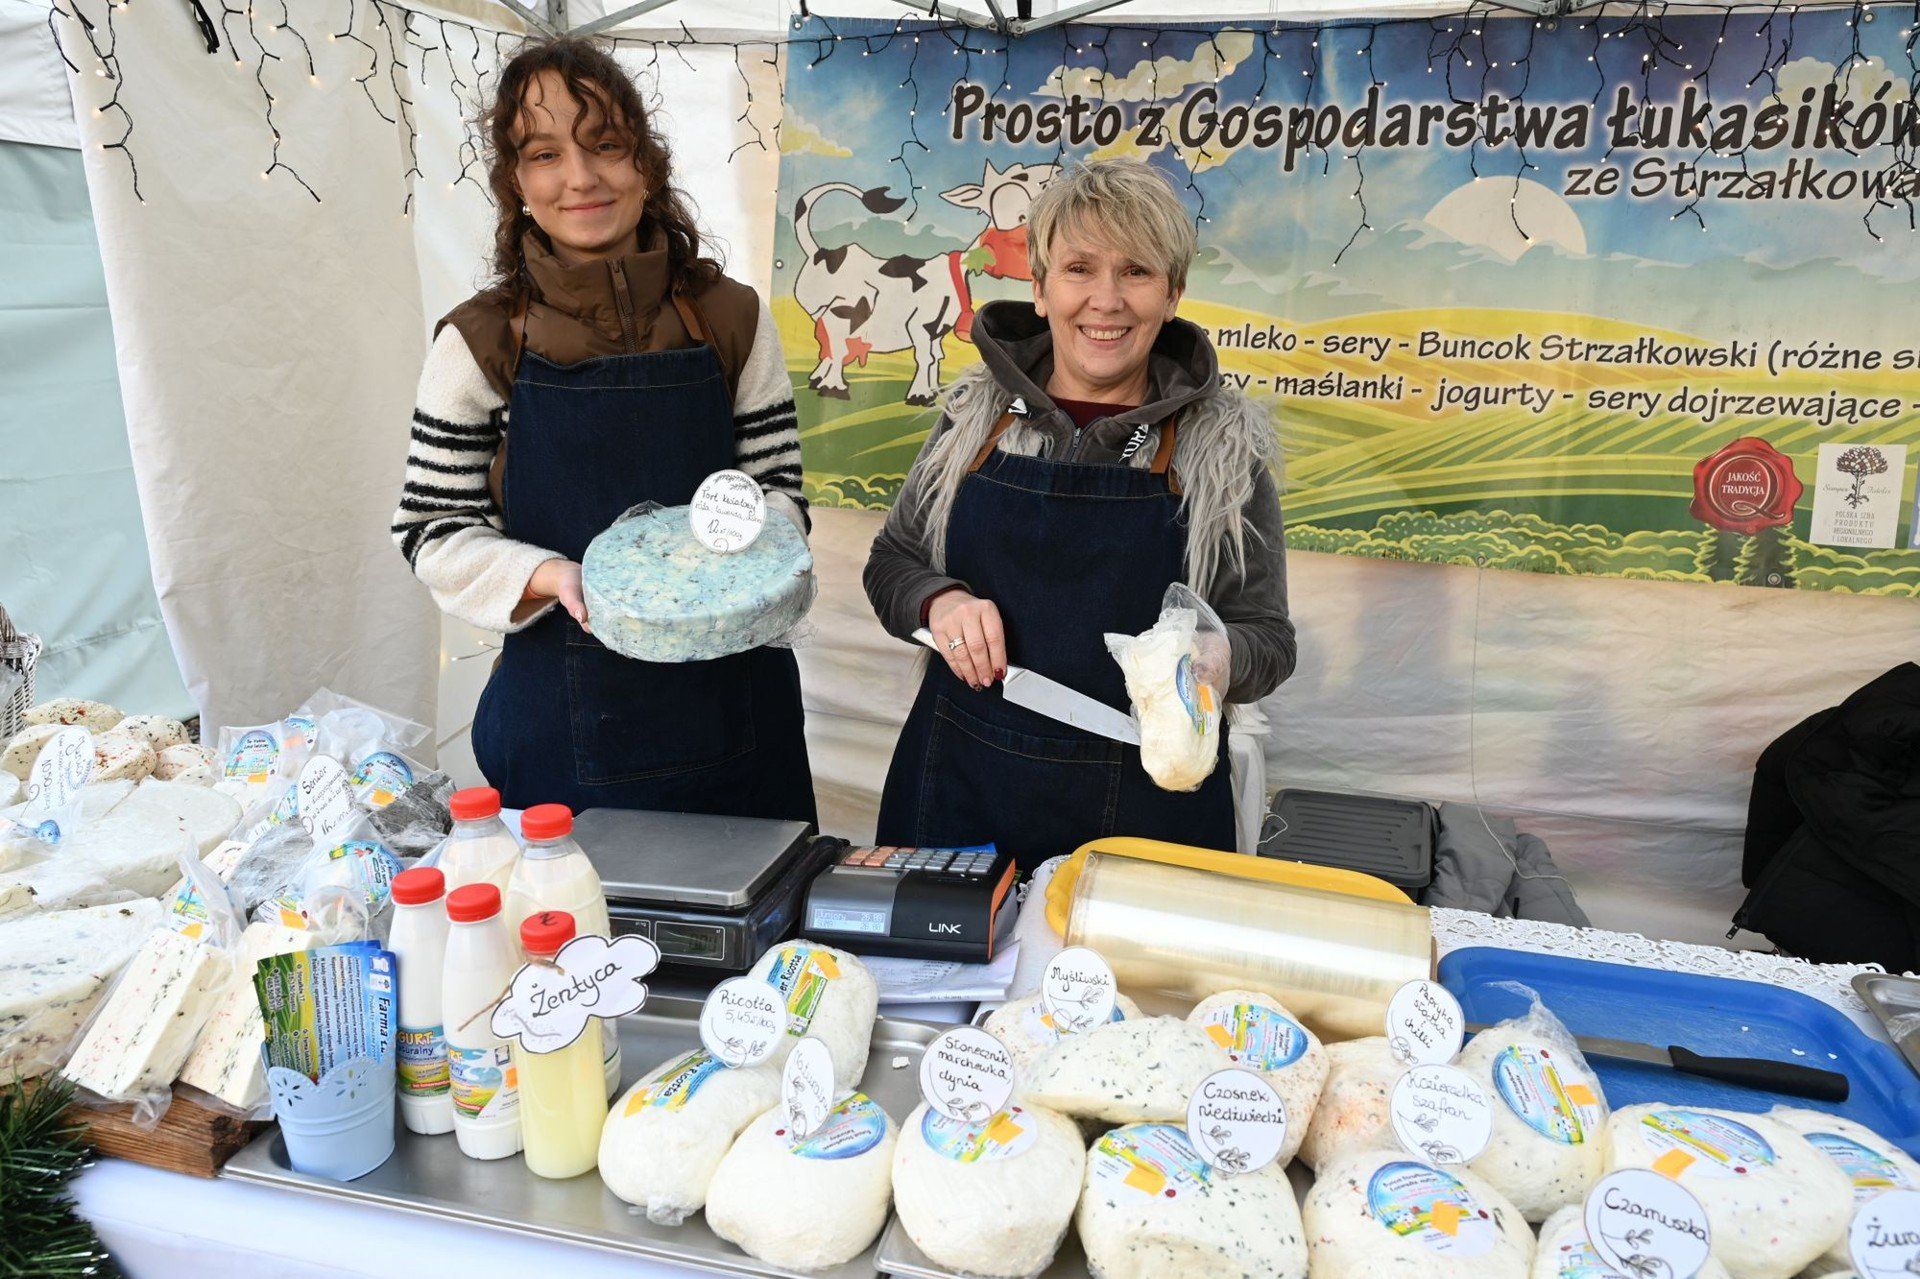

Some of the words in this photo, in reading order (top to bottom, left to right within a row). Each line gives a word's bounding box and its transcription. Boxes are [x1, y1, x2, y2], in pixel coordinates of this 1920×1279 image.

[953, 85, 1121, 146] Prosto
[1135, 107, 1166, 146] z
[1179, 86, 1588, 172] Gospodarstwa
[1563, 167, 1621, 196] ze
[1217, 323, 1297, 351] mleko
[1323, 333, 1391, 362] sery
[1418, 331, 1531, 361] Buncok
[1539, 333, 1758, 368] Strzałkowski
[1768, 339, 1882, 377] (różne
[1275, 371, 1404, 400] maślanki
[1431, 377, 1554, 414] jogurty
[1588, 388, 1661, 418] sery
[1667, 386, 1902, 427] dojrzewające
[1721, 483, 1766, 497] TRADYCJA
[1726, 471, 1761, 483] JAKOŚĆ
[928, 921, 961, 935] LINK
[780, 953, 802, 981] Ricotta
[1050, 966, 1110, 992] Myśliwski
[529, 961, 623, 1018] Żentyca
[719, 988, 777, 1014] Ricotta
[378, 996, 391, 1036] Farma
[939, 1069, 983, 1092] dynia
[1203, 1081, 1271, 1102] Czosnek
[1866, 1216, 1920, 1248] Żura
